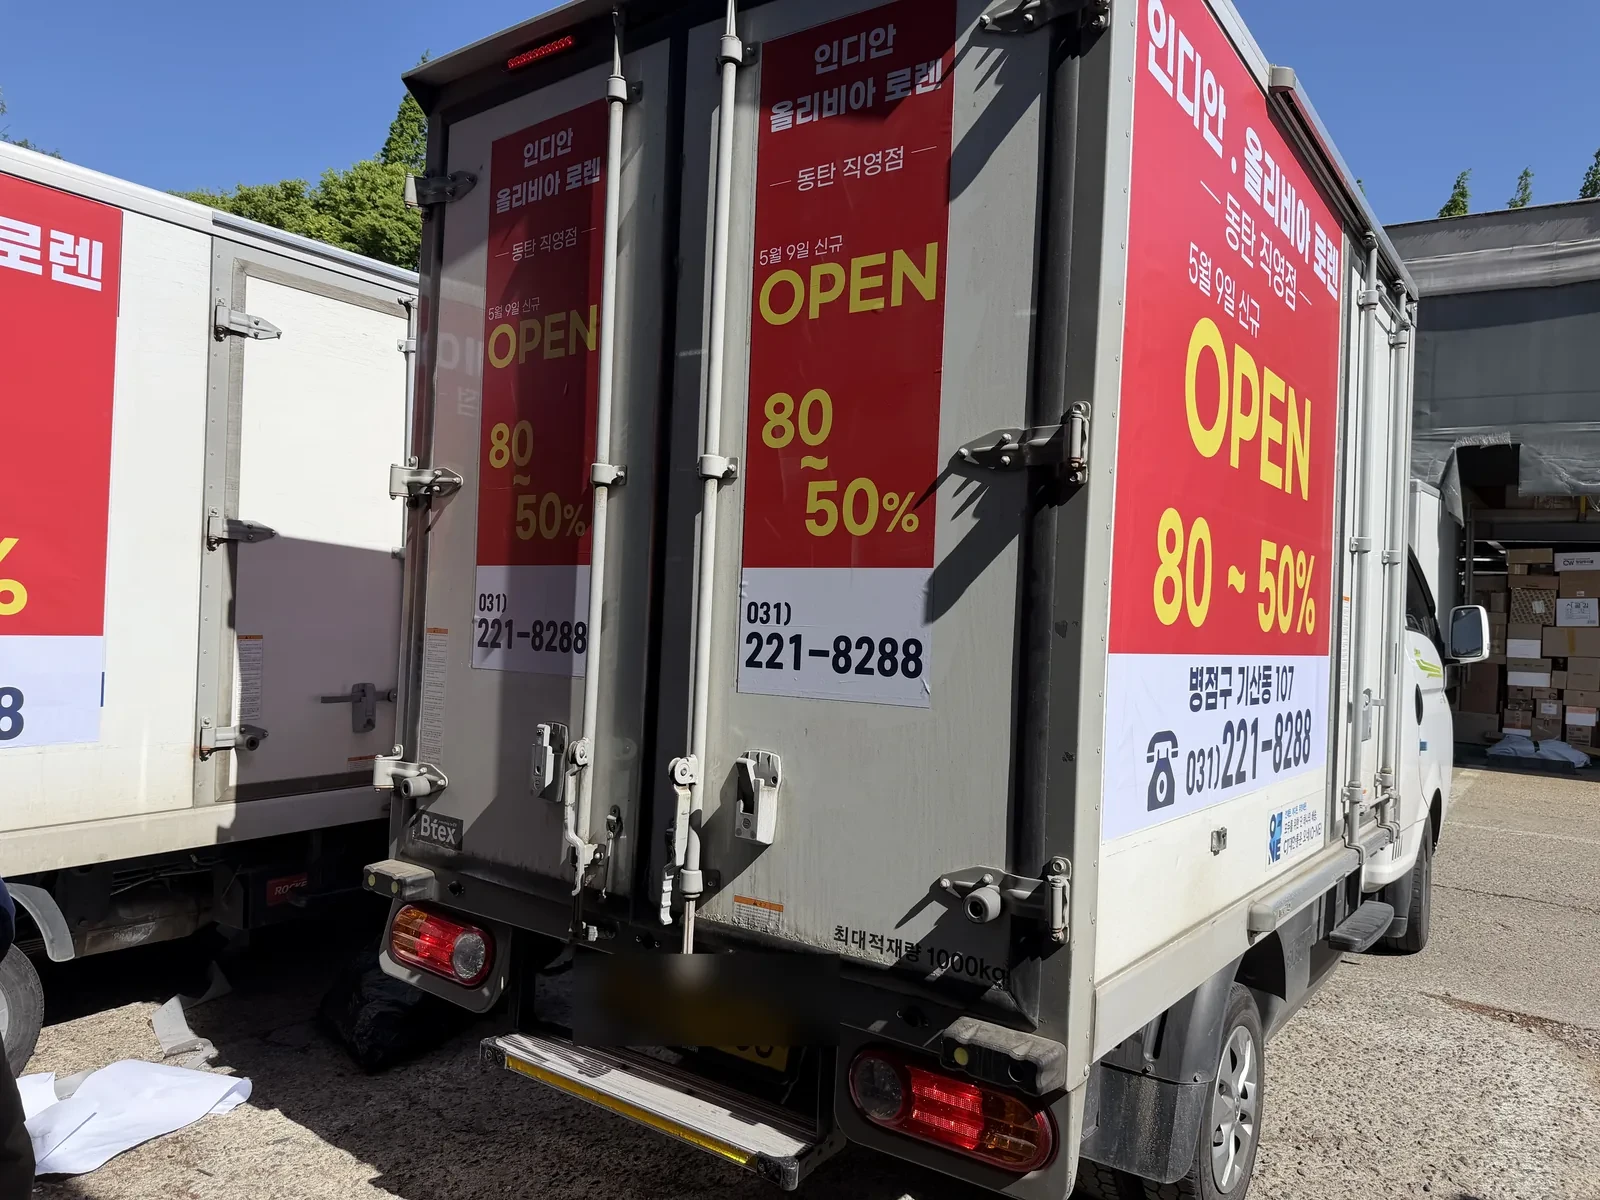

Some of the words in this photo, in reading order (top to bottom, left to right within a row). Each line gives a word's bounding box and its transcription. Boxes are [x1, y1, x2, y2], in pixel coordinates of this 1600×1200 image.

[814, 23, 897, 76] 인디안
[769, 77, 878, 133] 올리비아
[885, 57, 943, 103] 로렌
[523, 127, 574, 168] 인디안
[797, 161, 837, 192] 동탄
[842, 145, 905, 179] 직영점
[1147, 0, 1227, 159] 인디안
[1243, 126, 1312, 265] 올리비아
[1312, 221, 1340, 302] 로렌
[496, 171, 560, 214] 올리비아
[565, 156, 601, 192] 로렌
[0, 215, 103, 292] 로렌
[512, 241, 536, 262] 동탄
[539, 226, 577, 253] 직영점
[759, 247, 782, 266] 5월
[786, 240, 810, 261] 9일
[814, 234, 844, 258] 신규
[1225, 191, 1256, 269] 동탄
[1259, 230, 1297, 312] 직영점
[488, 305, 503, 321] 5월
[504, 301, 520, 317] 9일
[522, 297, 540, 315] 신규
[759, 242, 939, 326] OPEN
[1188, 241, 1212, 298] 5월
[1215, 267, 1236, 319] 9일
[1238, 289, 1261, 339] 신규
[487, 304, 598, 369] OPEN
[761, 388, 834, 449] 80
[1184, 317, 1311, 501] OPEN
[488, 419, 534, 469] 80
[515, 491, 586, 541] 50%
[805, 477, 919, 537] 50%
[1153, 507, 1213, 628] 80
[1257, 539, 1316, 636] 50%
[478, 593, 507, 613] 031)
[746, 601, 792, 626] 031)
[477, 617, 587, 654] 221-8288
[745, 631, 923, 679] 221-8288
[1189, 665, 1233, 713] 병점구
[1236, 665, 1273, 706] 기산동
[1275, 665, 1295, 702] 107
[833, 924, 922, 962] 최대적재량
[926, 946, 1006, 989] 1000kg
